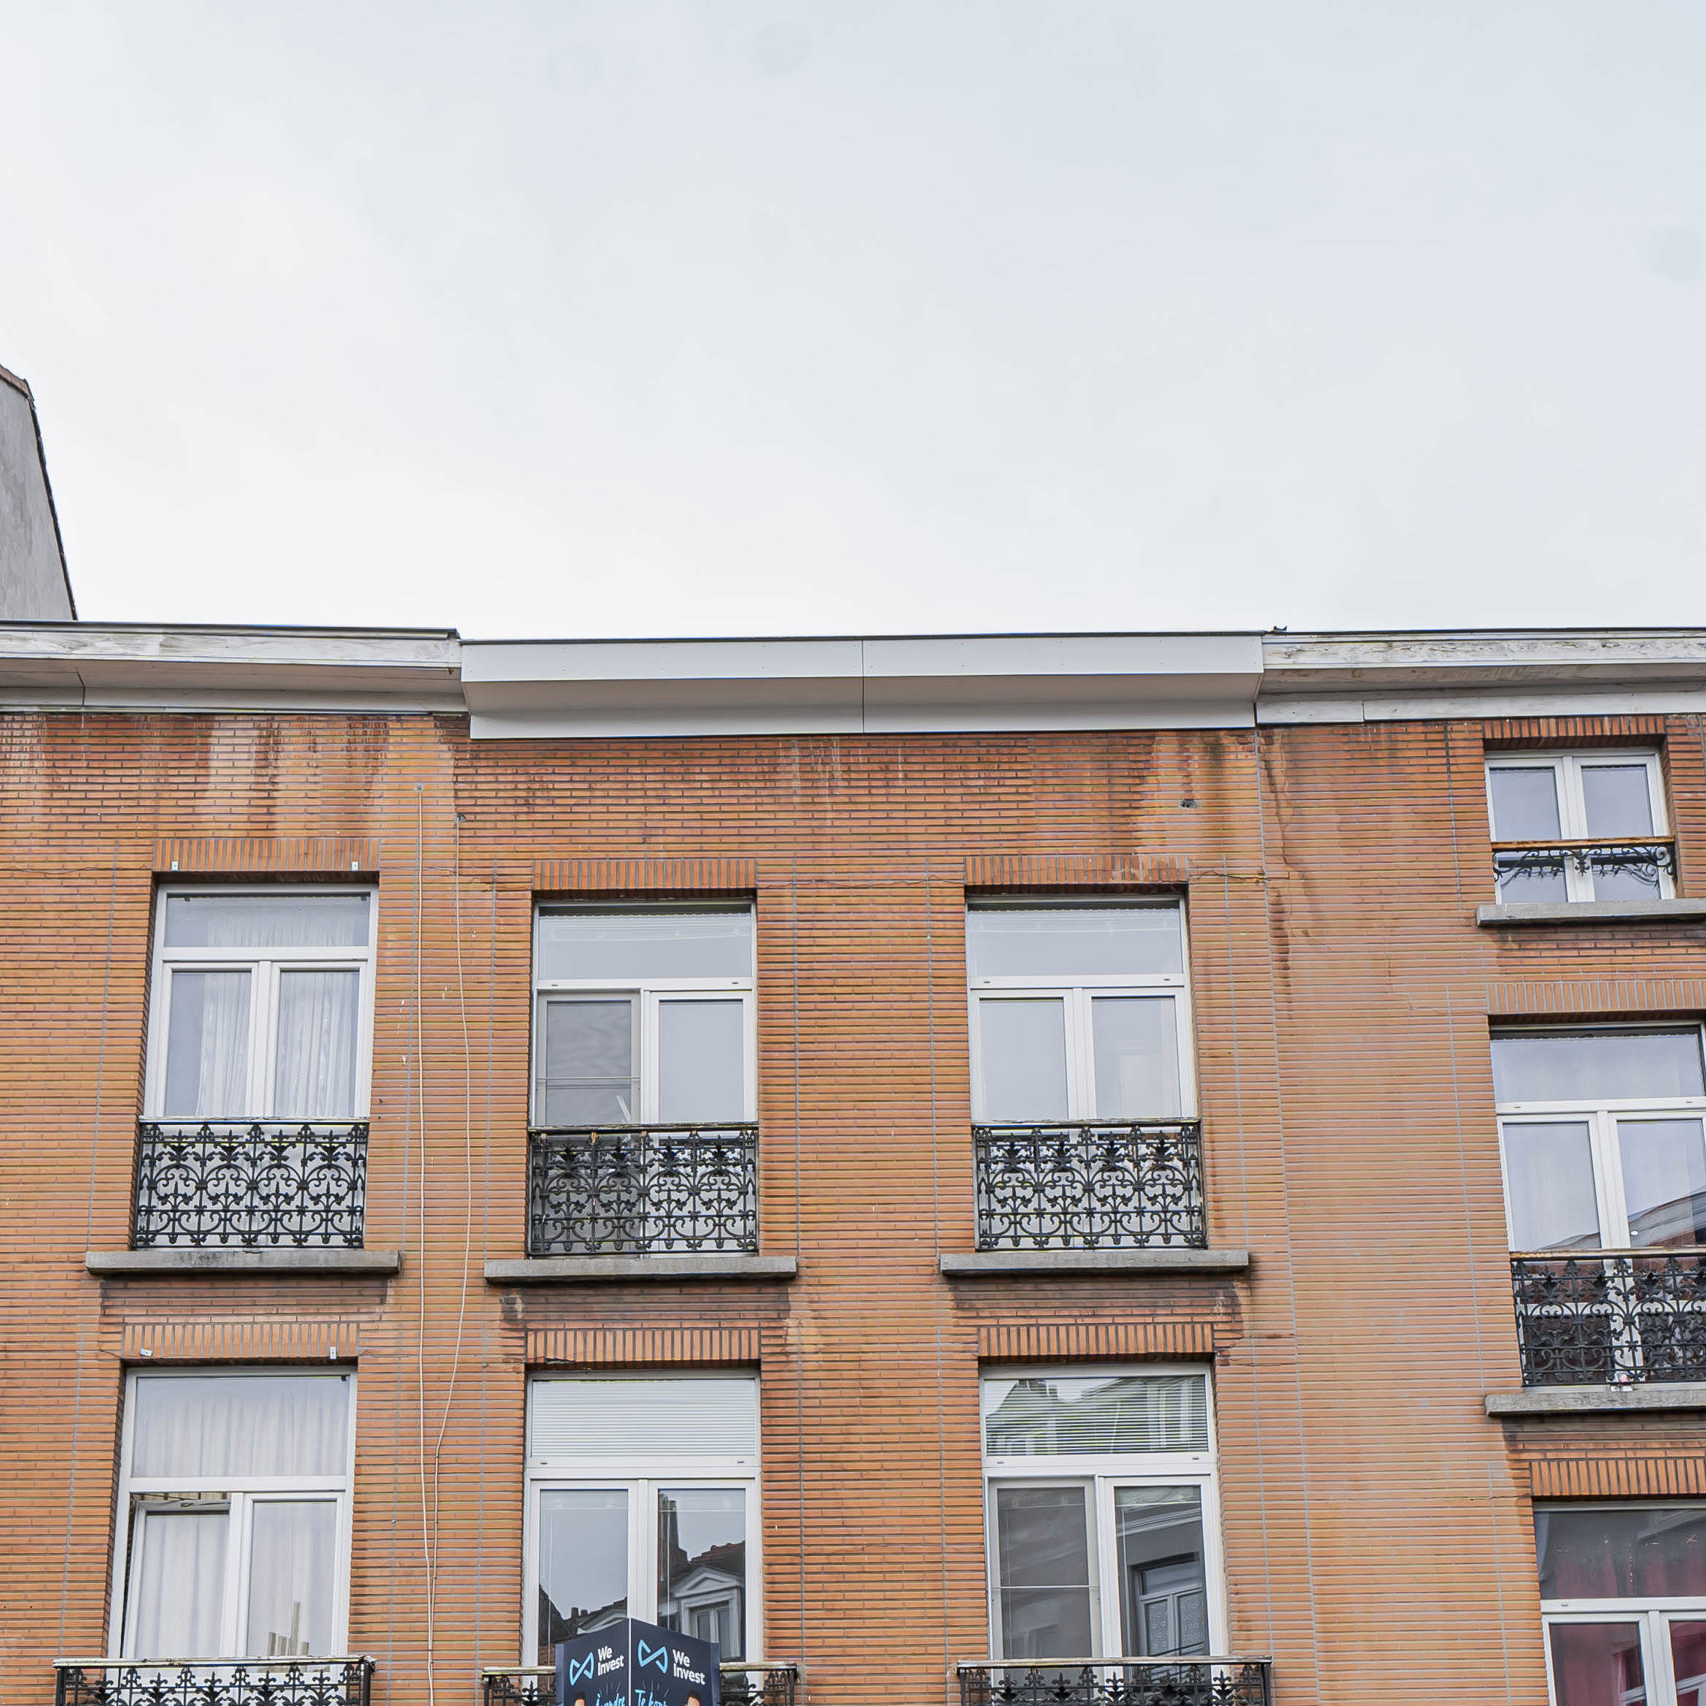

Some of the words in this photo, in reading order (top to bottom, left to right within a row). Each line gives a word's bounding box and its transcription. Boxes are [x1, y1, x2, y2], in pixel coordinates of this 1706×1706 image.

[597, 1646, 613, 1660] We
[672, 1649, 691, 1667] We
[597, 1655, 625, 1677] Invest
[673, 1665, 706, 1686] Invest
